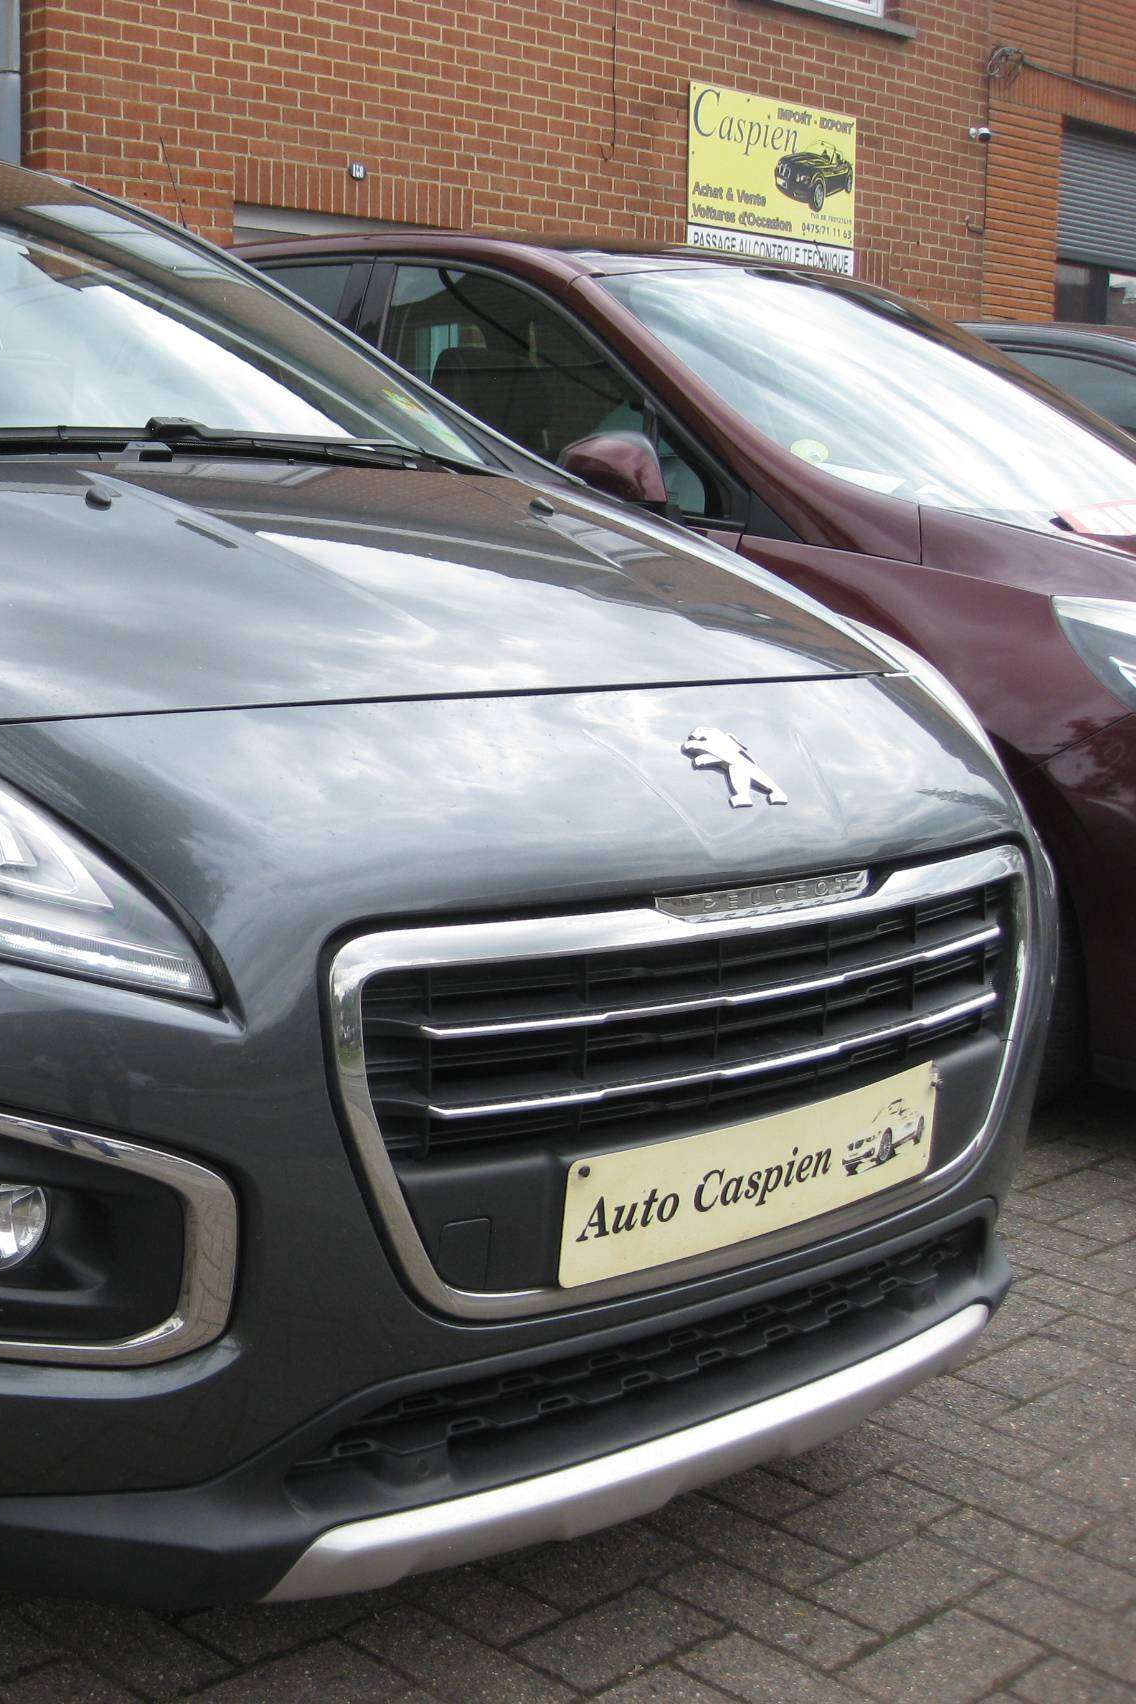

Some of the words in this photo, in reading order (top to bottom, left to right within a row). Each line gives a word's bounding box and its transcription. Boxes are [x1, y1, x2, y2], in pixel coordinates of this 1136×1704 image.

[693, 88, 799, 156] Caspien
[777, 107, 812, 126] IMPORT
[819, 117, 854, 135] EXPORT
[692, 181, 724, 200] Achat
[726, 187, 734, 201] &
[736, 189, 767, 207] Vente
[692, 203, 736, 223] Voitures
[738, 211, 792, 232] d'Occasion
[693, 231, 737, 251] PASSAGE
[843, 230, 852, 240] 63
[703, 876, 848, 913] PEUGEOT
[575, 1188, 680, 1243] Auto
[693, 1146, 833, 1213] Caspien
